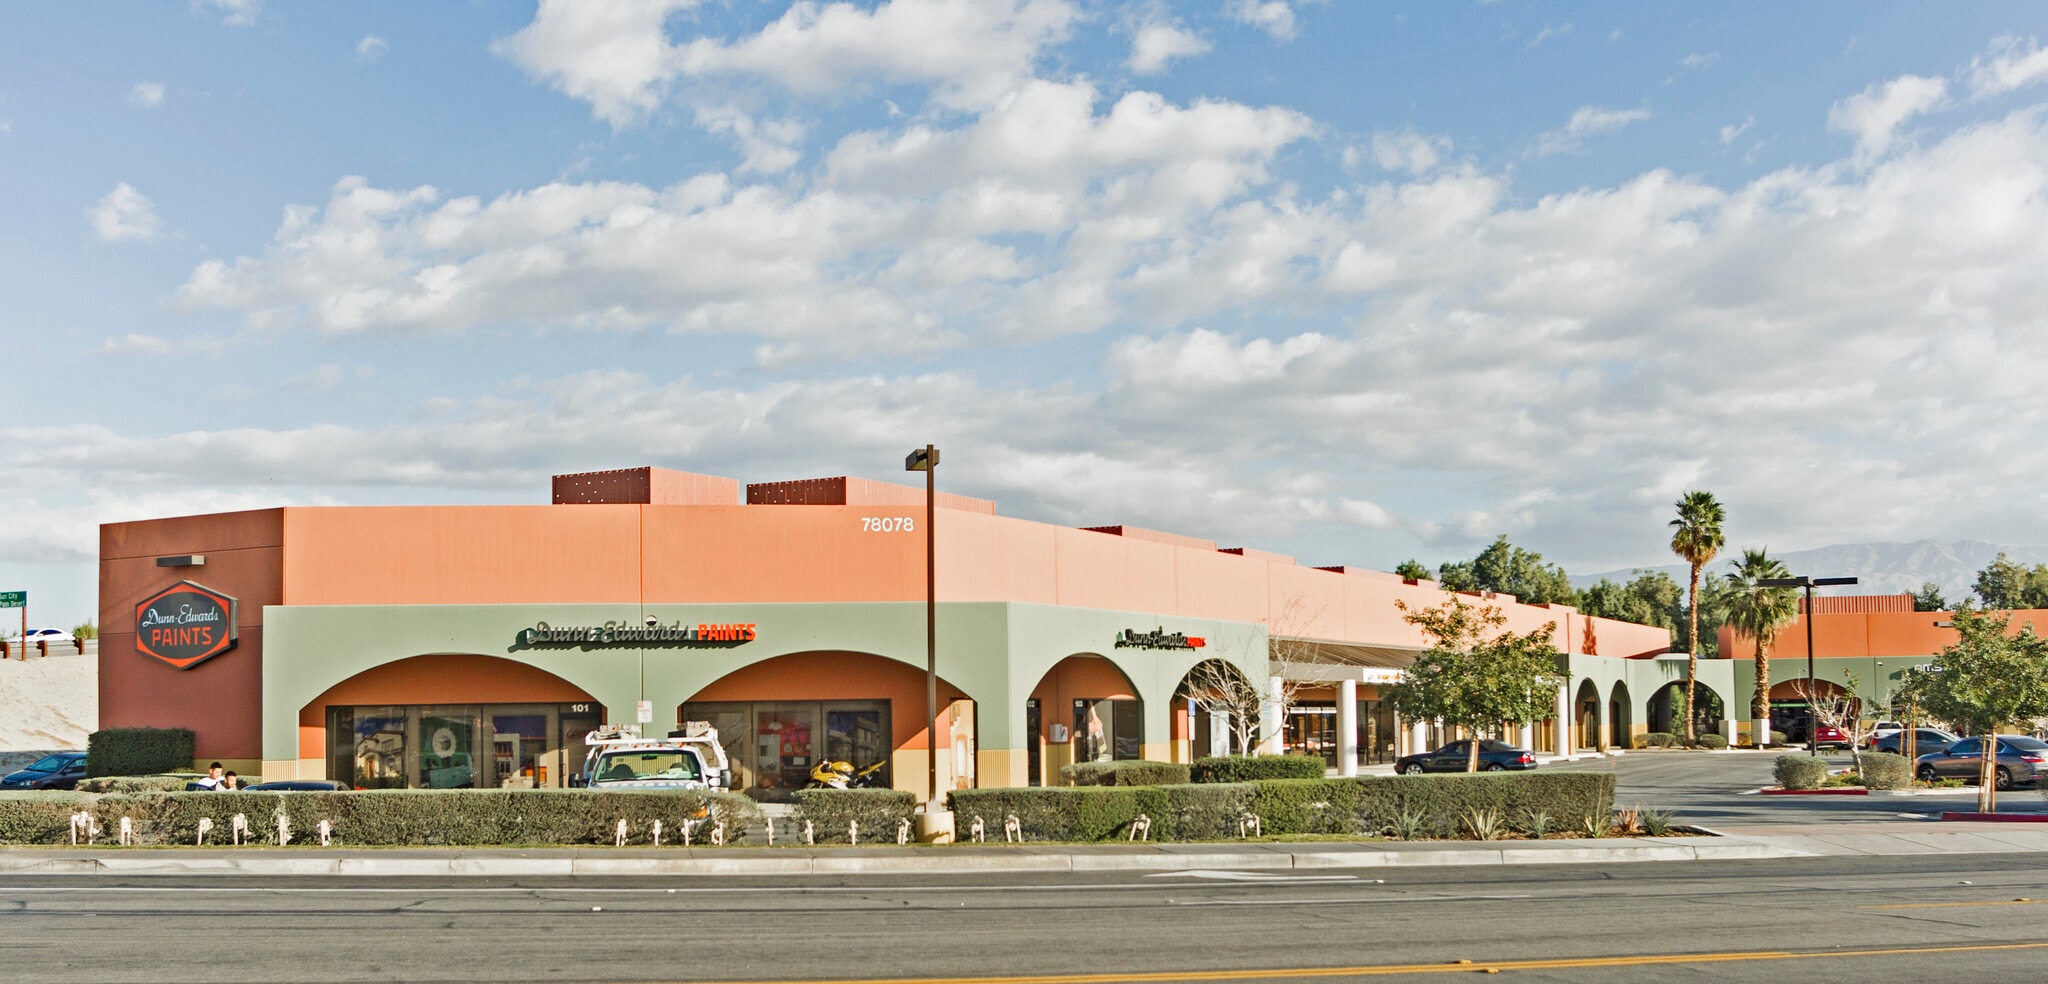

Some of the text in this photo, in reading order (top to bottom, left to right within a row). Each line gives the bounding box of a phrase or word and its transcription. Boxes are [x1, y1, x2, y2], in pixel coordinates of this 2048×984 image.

[861, 516, 914, 532] 78078
[142, 604, 219, 628] Dunn-Edwards
[152, 626, 212, 647] PAINTS
[527, 620, 756, 644] Dunn-Edwards PAINTS
[571, 704, 589, 712] 101
